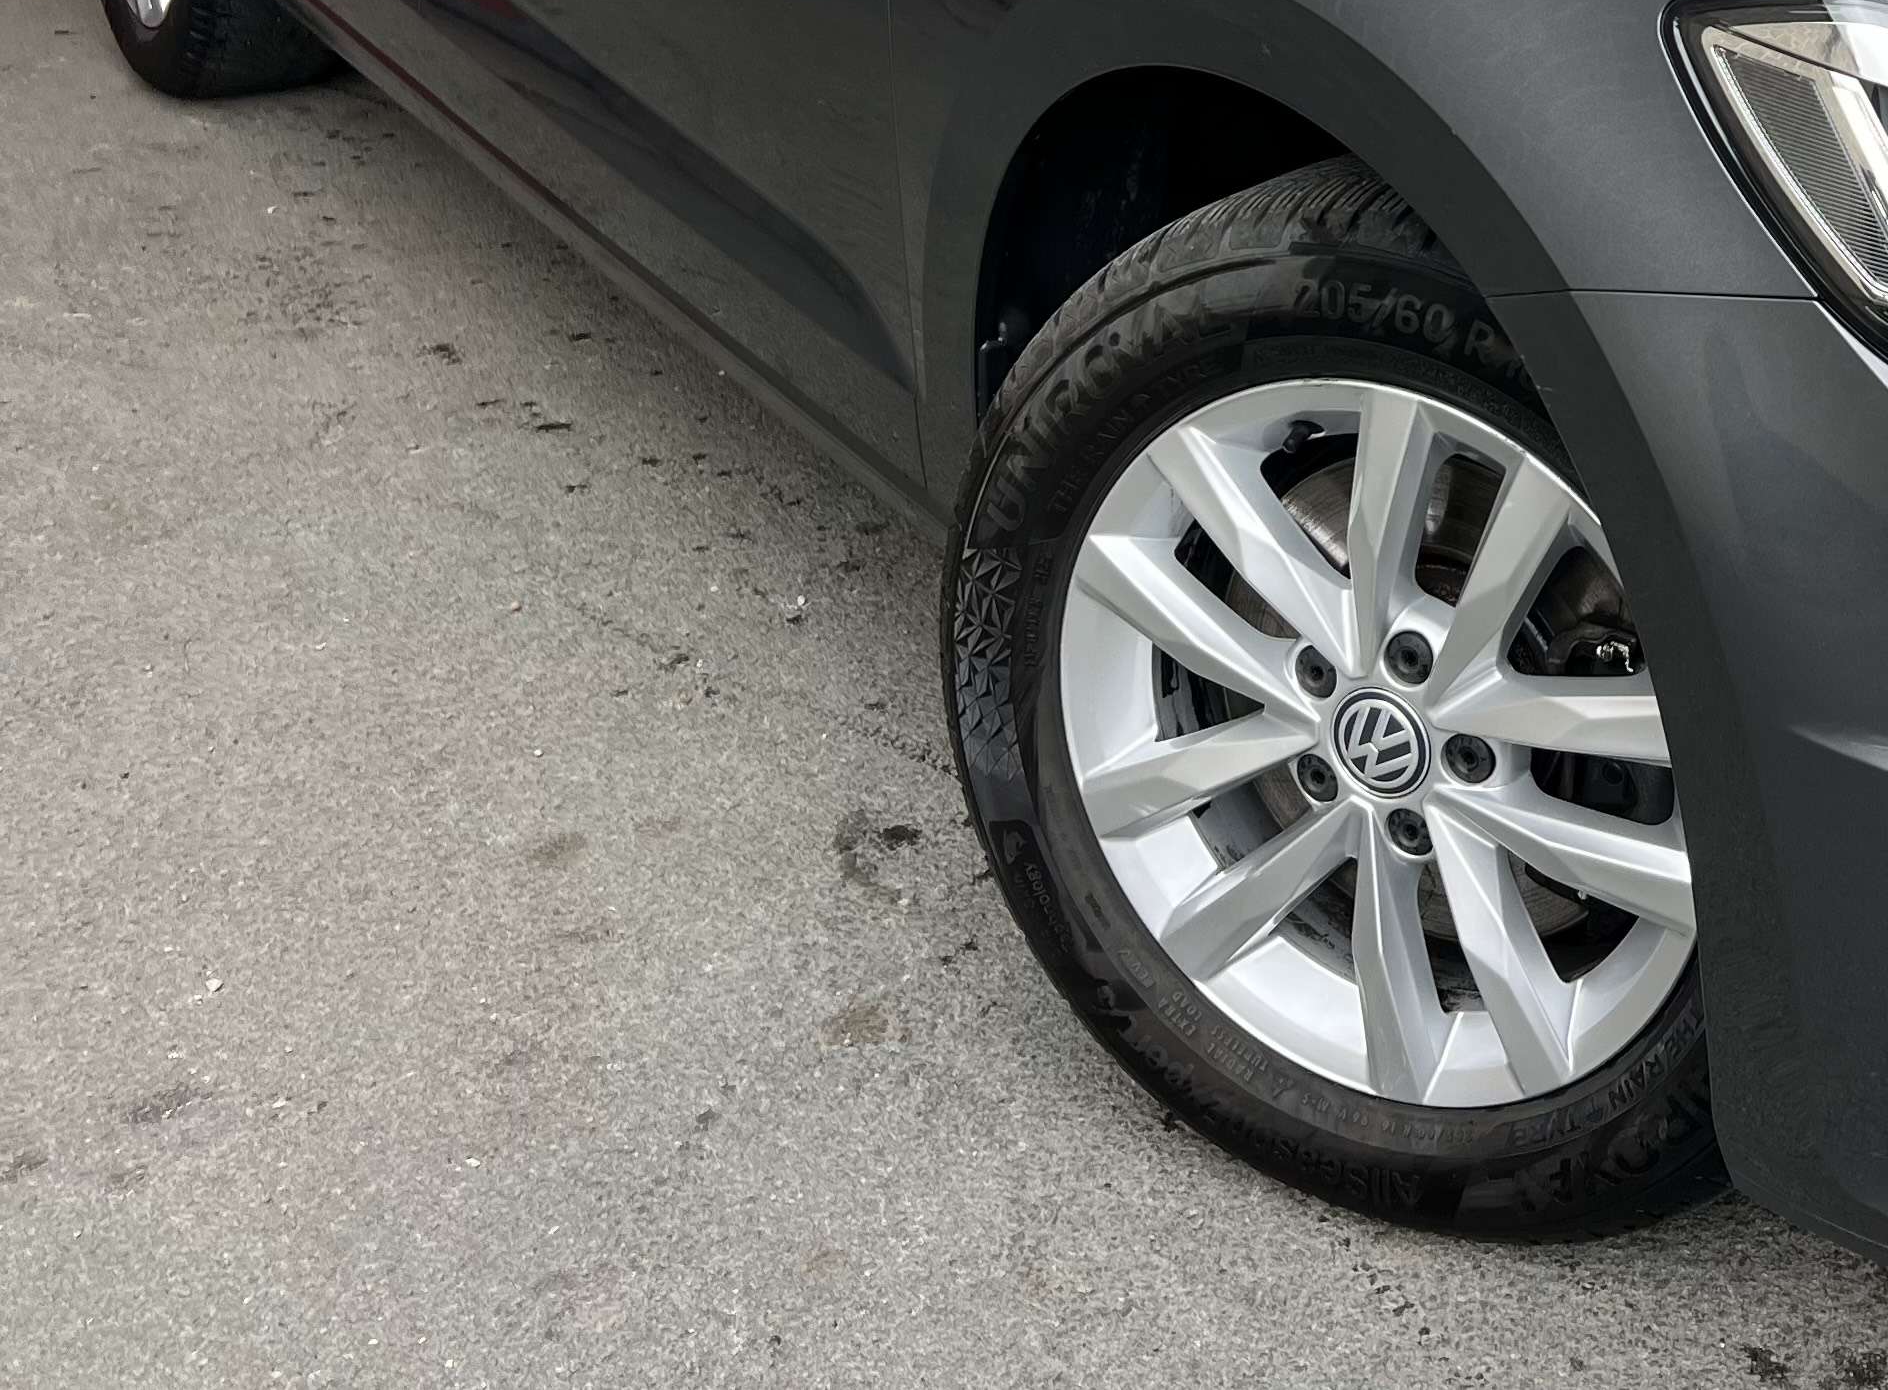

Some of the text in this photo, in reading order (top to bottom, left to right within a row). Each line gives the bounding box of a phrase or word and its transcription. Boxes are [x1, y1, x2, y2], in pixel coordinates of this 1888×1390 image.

[1293, 278, 1454, 345] 205/60
[1157, 996, 1199, 1038] EXTRA
[1170, 989, 1203, 1022] LOAD
[1206, 1041, 1255, 1082] RADIAL
[1608, 1053, 1666, 1110] RAIN
